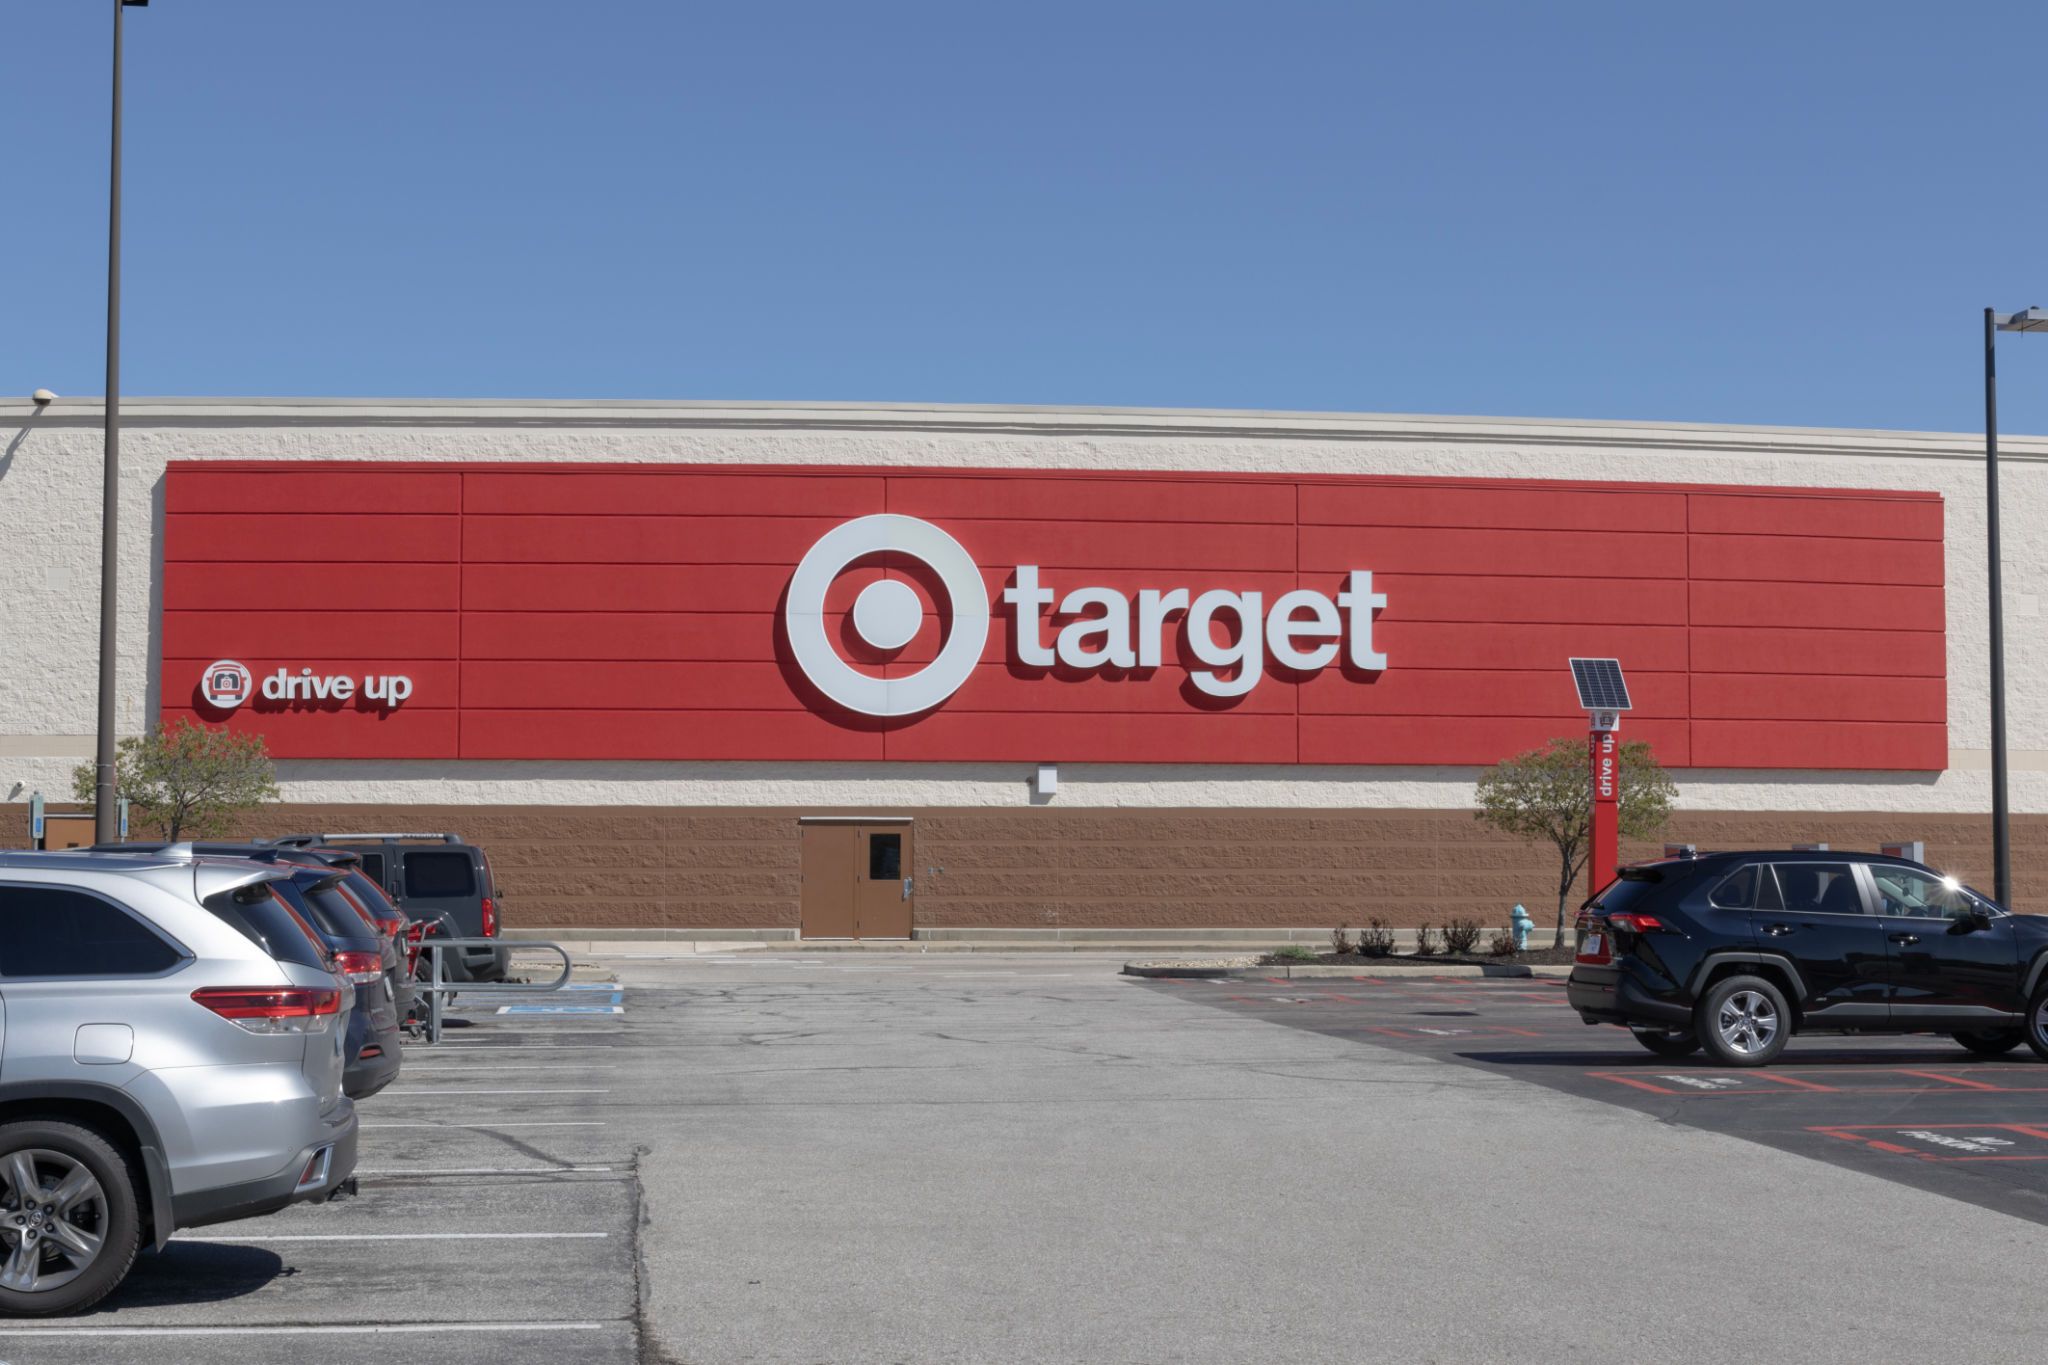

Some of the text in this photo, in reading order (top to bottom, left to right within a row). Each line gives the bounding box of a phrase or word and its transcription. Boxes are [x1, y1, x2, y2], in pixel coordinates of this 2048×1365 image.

[1003, 564, 1388, 698] target
[261, 667, 413, 707] drive up
[1599, 733, 1615, 797] drive up
